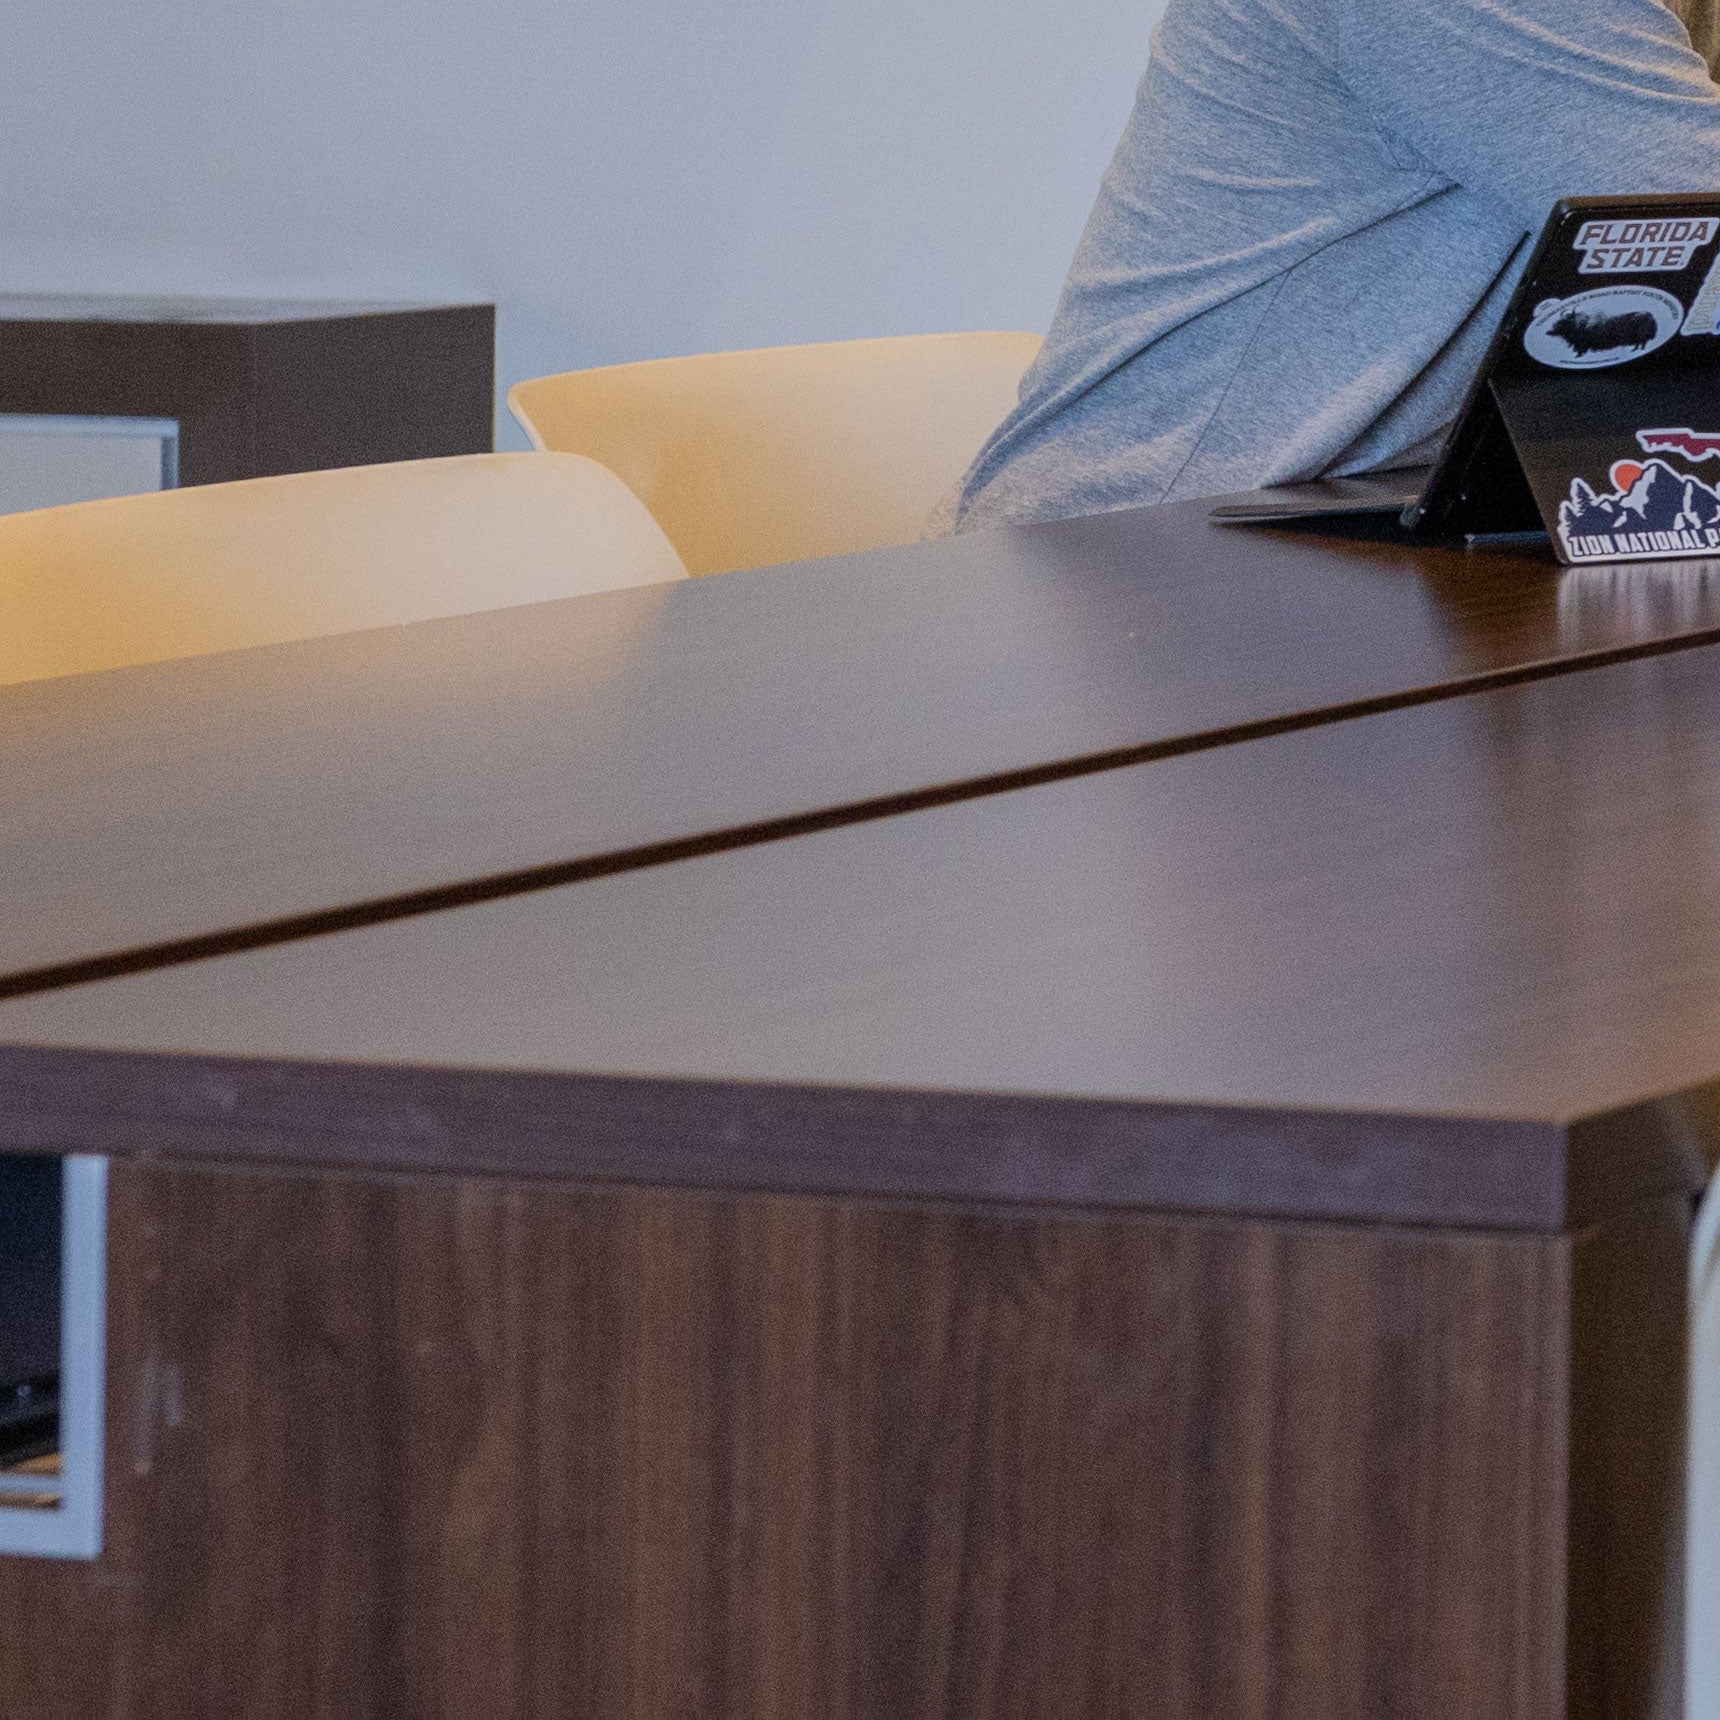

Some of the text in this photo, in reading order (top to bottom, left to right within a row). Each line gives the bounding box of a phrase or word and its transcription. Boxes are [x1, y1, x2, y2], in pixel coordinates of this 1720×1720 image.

[1579, 221, 1709, 246] FLORIDA
[1586, 245, 1685, 270] STATE
[1568, 536, 1614, 557] ZION
[1614, 529, 1702, 554] NATIONAL
